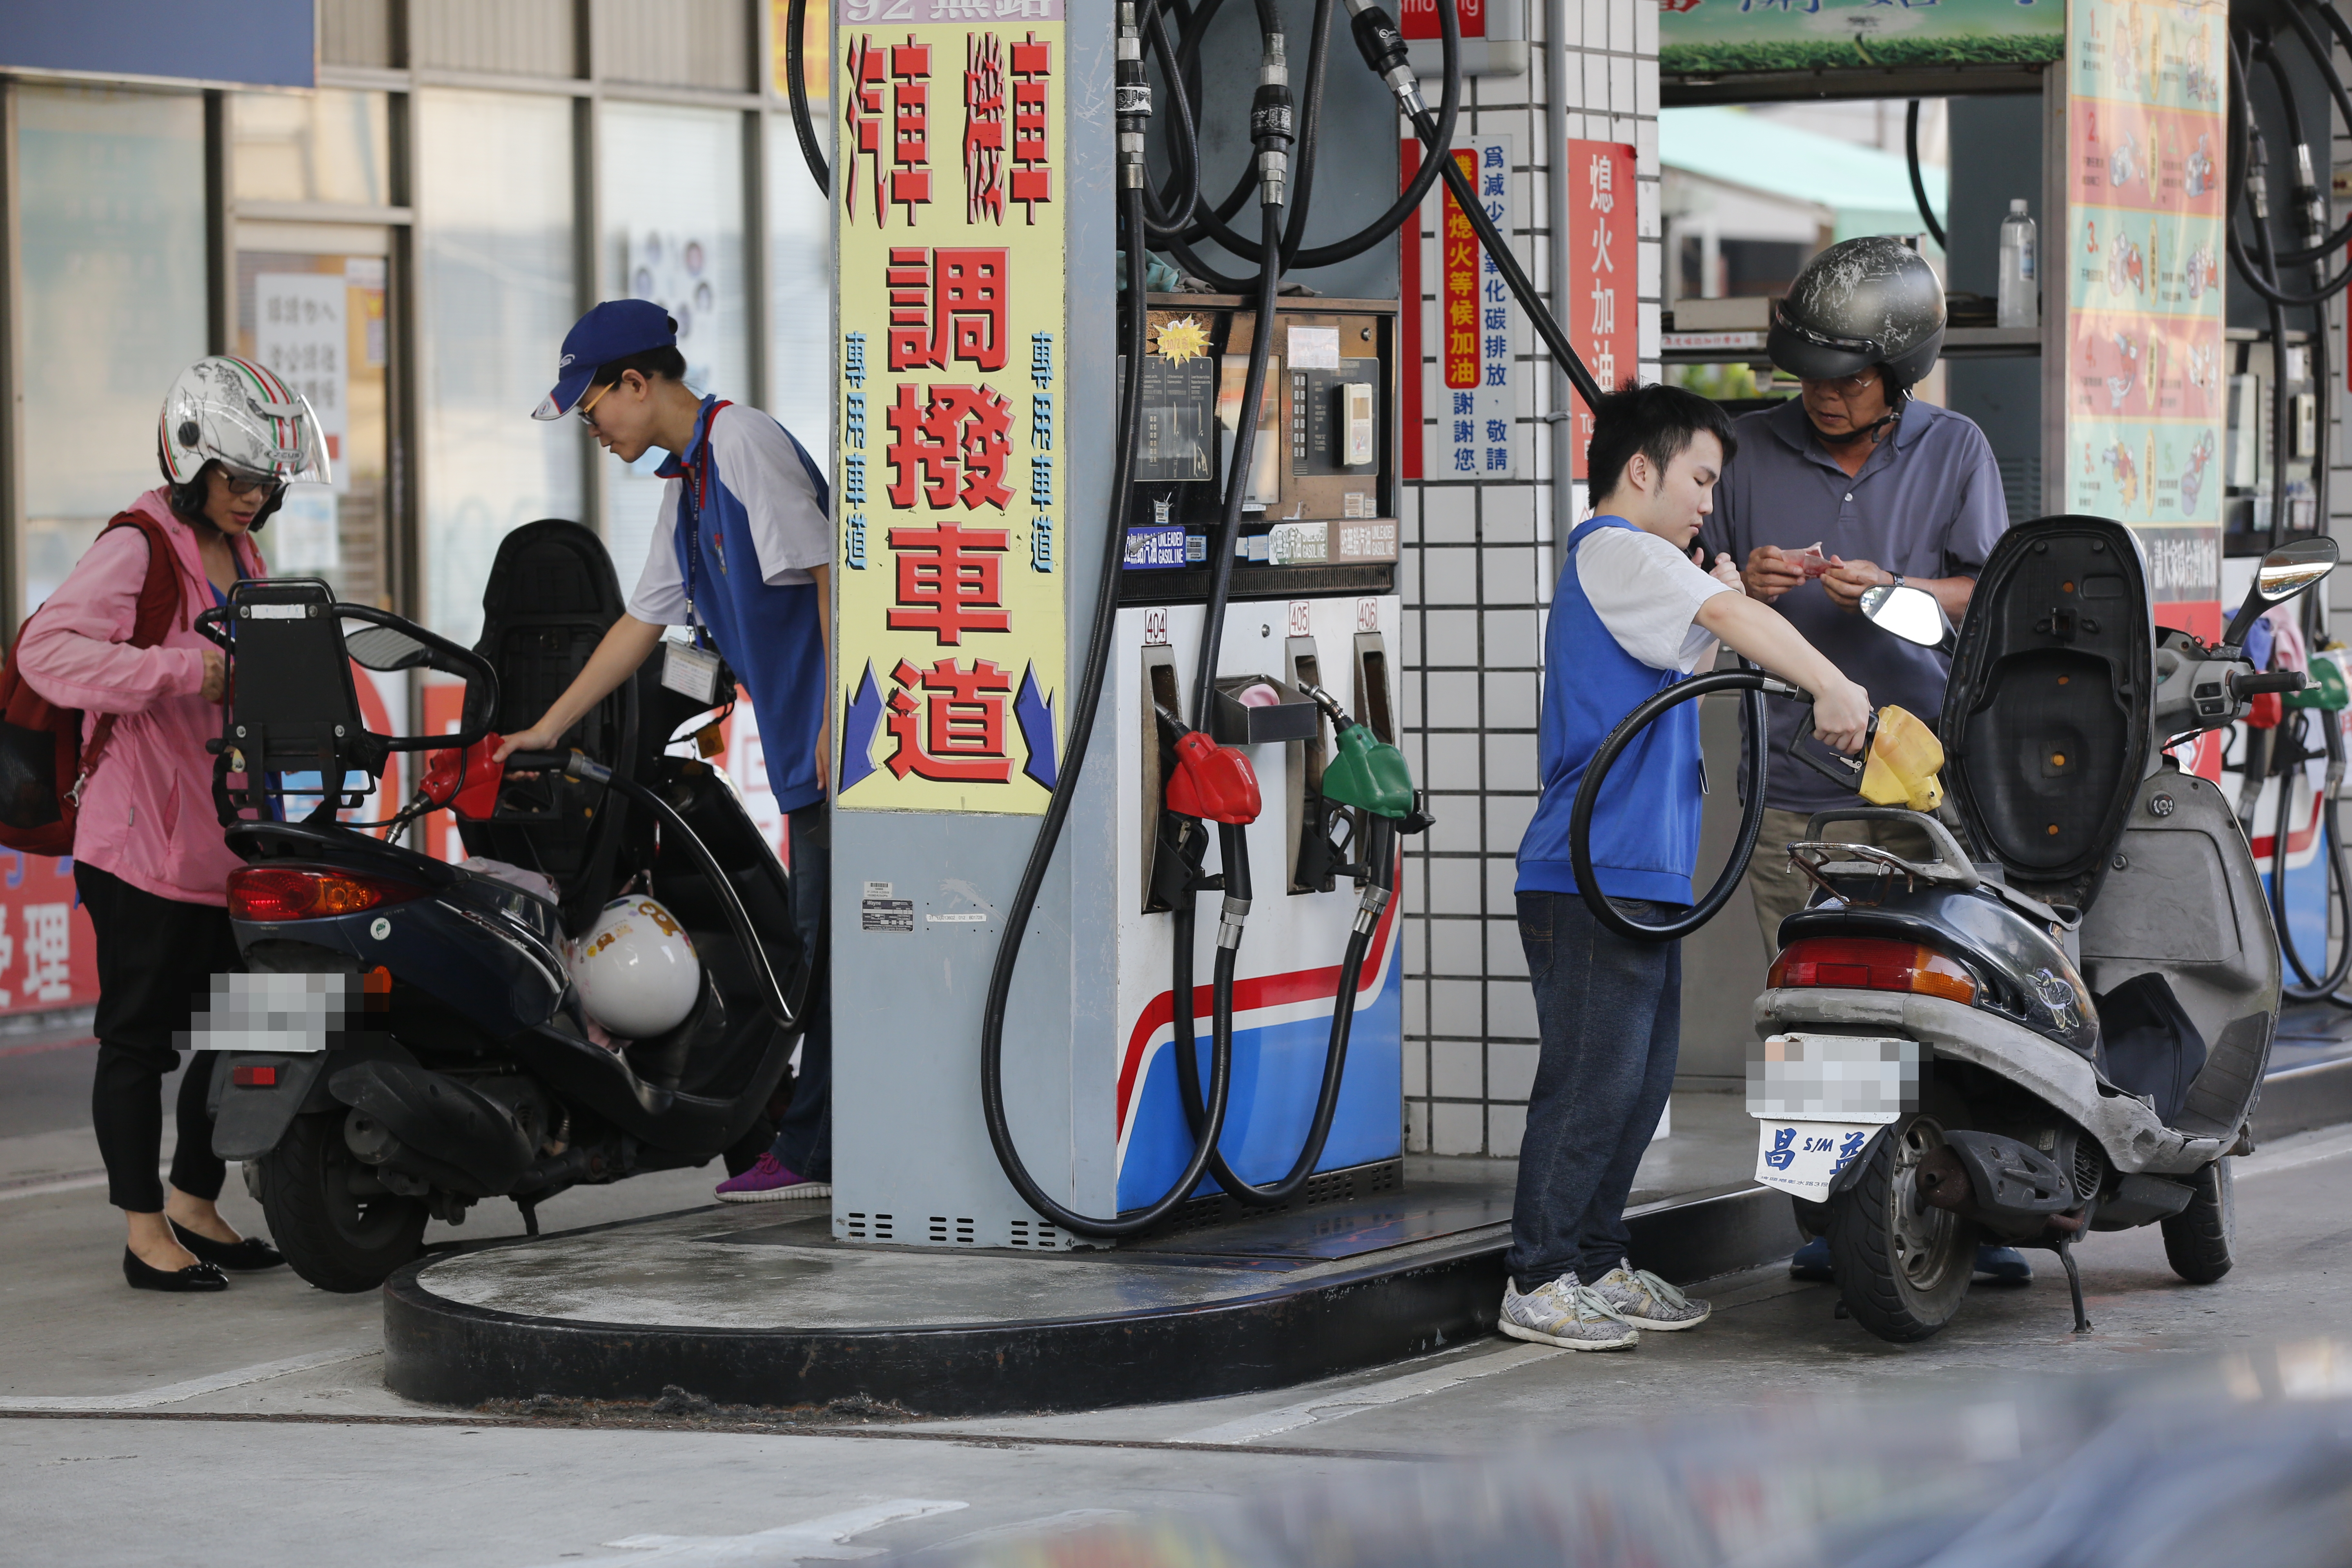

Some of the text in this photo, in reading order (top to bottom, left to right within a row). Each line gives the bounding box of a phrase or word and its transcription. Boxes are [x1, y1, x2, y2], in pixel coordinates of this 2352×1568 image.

[846, 31, 1052, 229] 汽車 機車
[1589, 154, 1615, 390] 熄火加油
[884, 247, 1017, 785] 調撥車道
[1158, 531, 1183, 547] UNLEADED
[1371, 525, 1394, 540] UNLEADED
[1158, 548, 1184, 564] GASOLINE
[1303, 543, 1326, 558] GASOLINE
[1371, 541, 1394, 556] GASOLINE
[1147, 613, 1165, 639] 404
[1291, 606, 1308, 632] 405
[1358, 602, 1375, 627] 406
[1599, 731, 1613, 750] OPW
[1614, 719, 1626, 731] VAPOR
[1626, 702, 1646, 718] RECOVERY
[1646, 694, 1657, 702] HOSE
[1765, 1128, 1797, 1171] 昌
